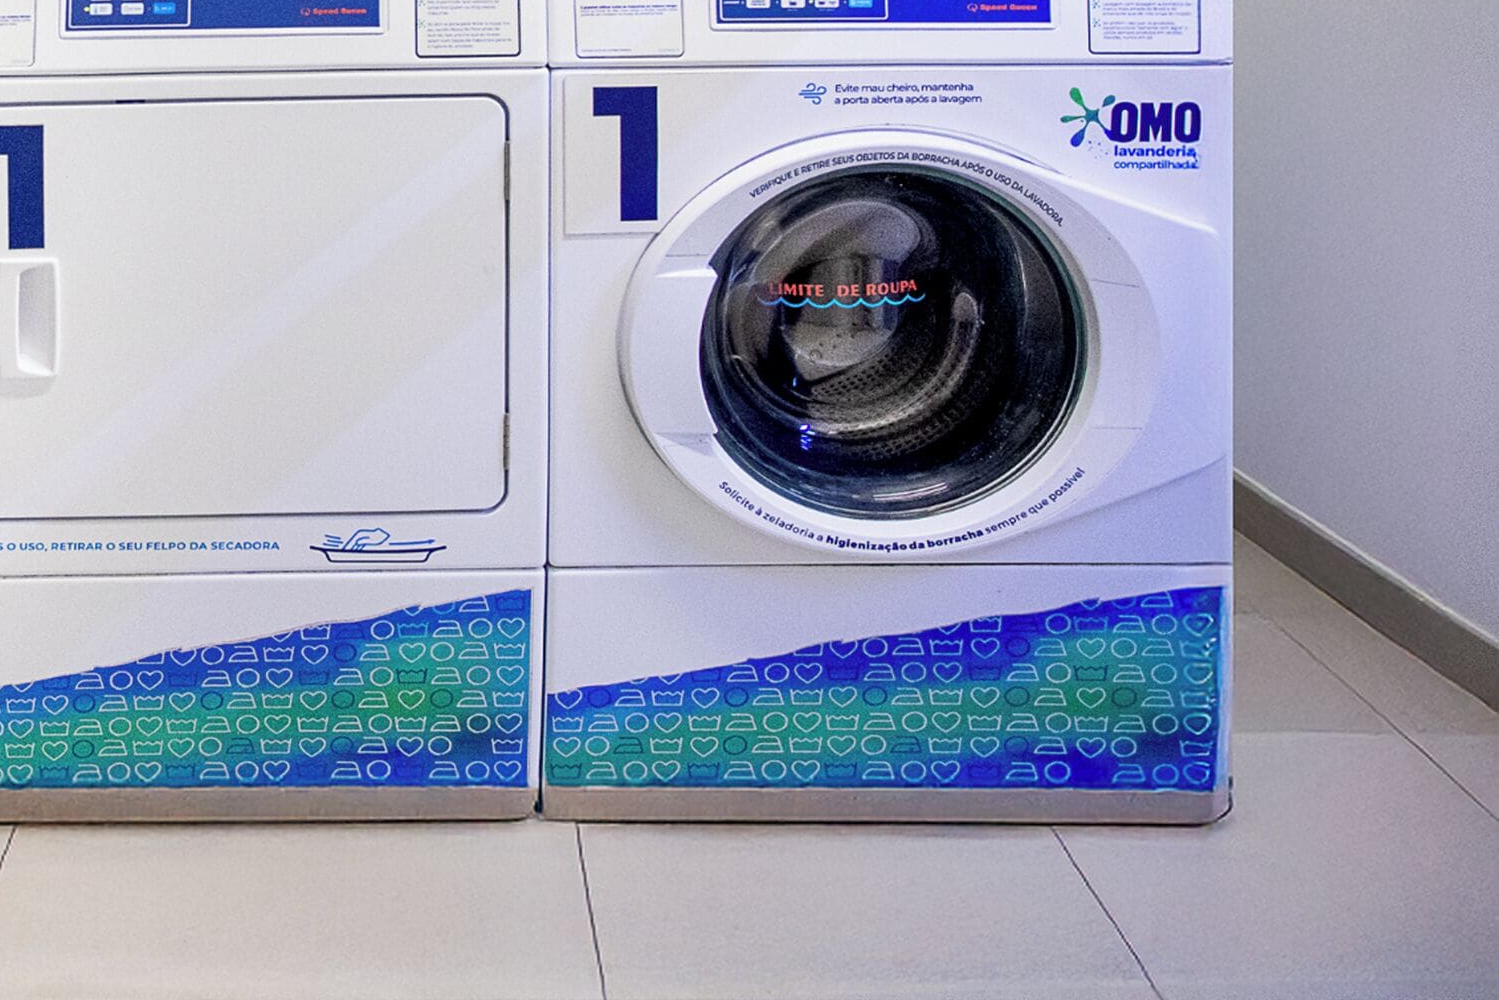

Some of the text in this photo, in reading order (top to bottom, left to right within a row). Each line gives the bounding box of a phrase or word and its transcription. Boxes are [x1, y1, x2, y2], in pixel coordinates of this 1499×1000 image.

[835, 83, 974, 93] Evite mau cheiro, mantenha
[843, 97, 869, 106] porta
[871, 95, 903, 105] aberta
[905, 95, 929, 106] após
[939, 95, 982, 105] lavagem
[1111, 102, 1201, 143] OMO
[593, 87, 658, 222] 1
[1114, 145, 1197, 157] lavanderia
[1114, 160, 1199, 170] compartilhada
[749, 170, 793, 198] VERIFIQUE
[794, 168, 799, 176] E
[801, 158, 831, 174] RETIRE
[832, 154, 854, 167] SEUS
[856, 152, 895, 162] OBJETOS
[897, 152, 910, 160] DA
[911, 152, 960, 167] BORRACHA
[961, 160, 985, 175] APÓS
[985, 169, 993, 177] O
[993, 172, 1012, 186] USO
[1011, 180, 1024, 193] DA
[769, 279, 917, 297] LIMITE DE ROUPA
[719, 481, 754, 511] Solicite
[762, 511, 815, 540] zeladoria
[826, 534, 907, 553] higienização
[909, 541, 925, 550] da
[927, 529, 984, 548] borracha
[985, 510, 1028, 534] sempre
[1028, 498, 1049, 514] que
[6, 542, 16, 551] O
[19, 542, 48, 552] USO,
[51, 541, 103, 550] RETIRAR
[106, 541, 116, 550] O
[118, 541, 143, 550] SEU
[146, 541, 186, 550] FELPO
[189, 541, 208, 550] DA
[210, 541, 280, 550] SECADORA
